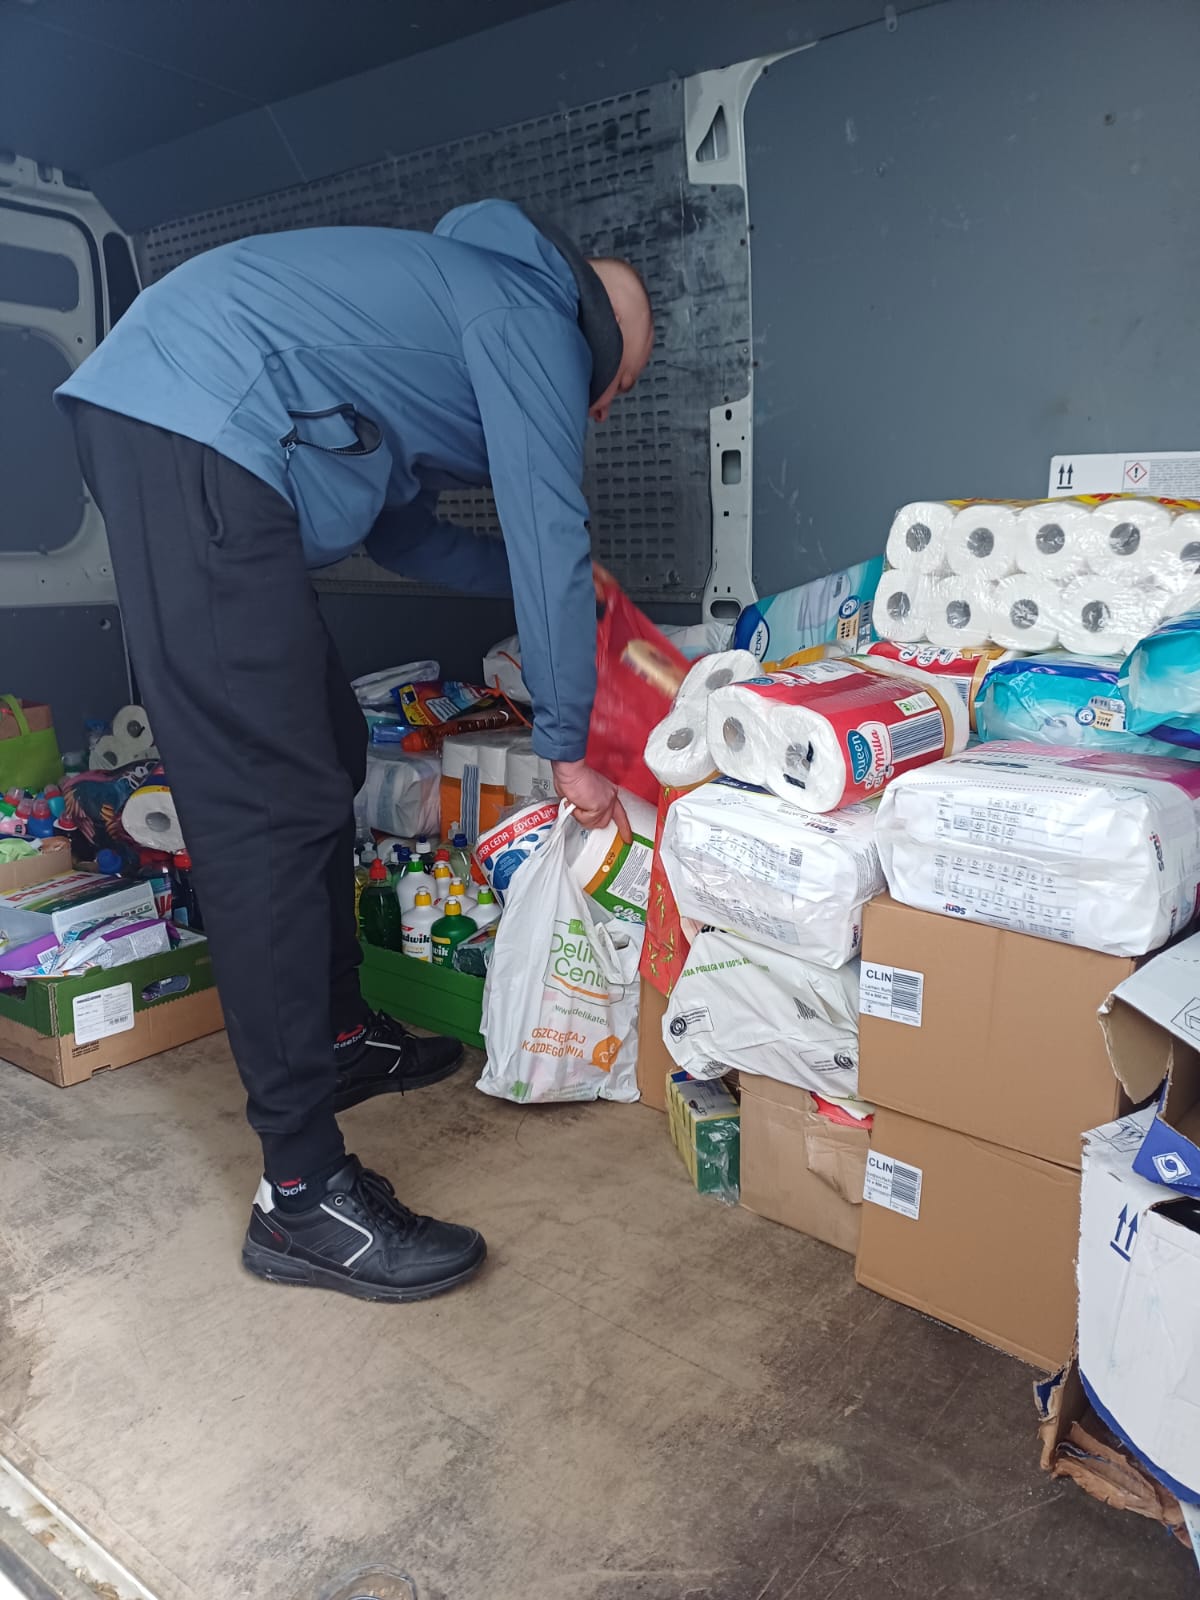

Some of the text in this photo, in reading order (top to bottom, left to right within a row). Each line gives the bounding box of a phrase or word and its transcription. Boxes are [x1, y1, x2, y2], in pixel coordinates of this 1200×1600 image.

[851, 734, 868, 781] Queen
[866, 969, 892, 983] CLIN
[333, 1027, 367, 1050] Reebok
[868, 1157, 893, 1174] CLIN
